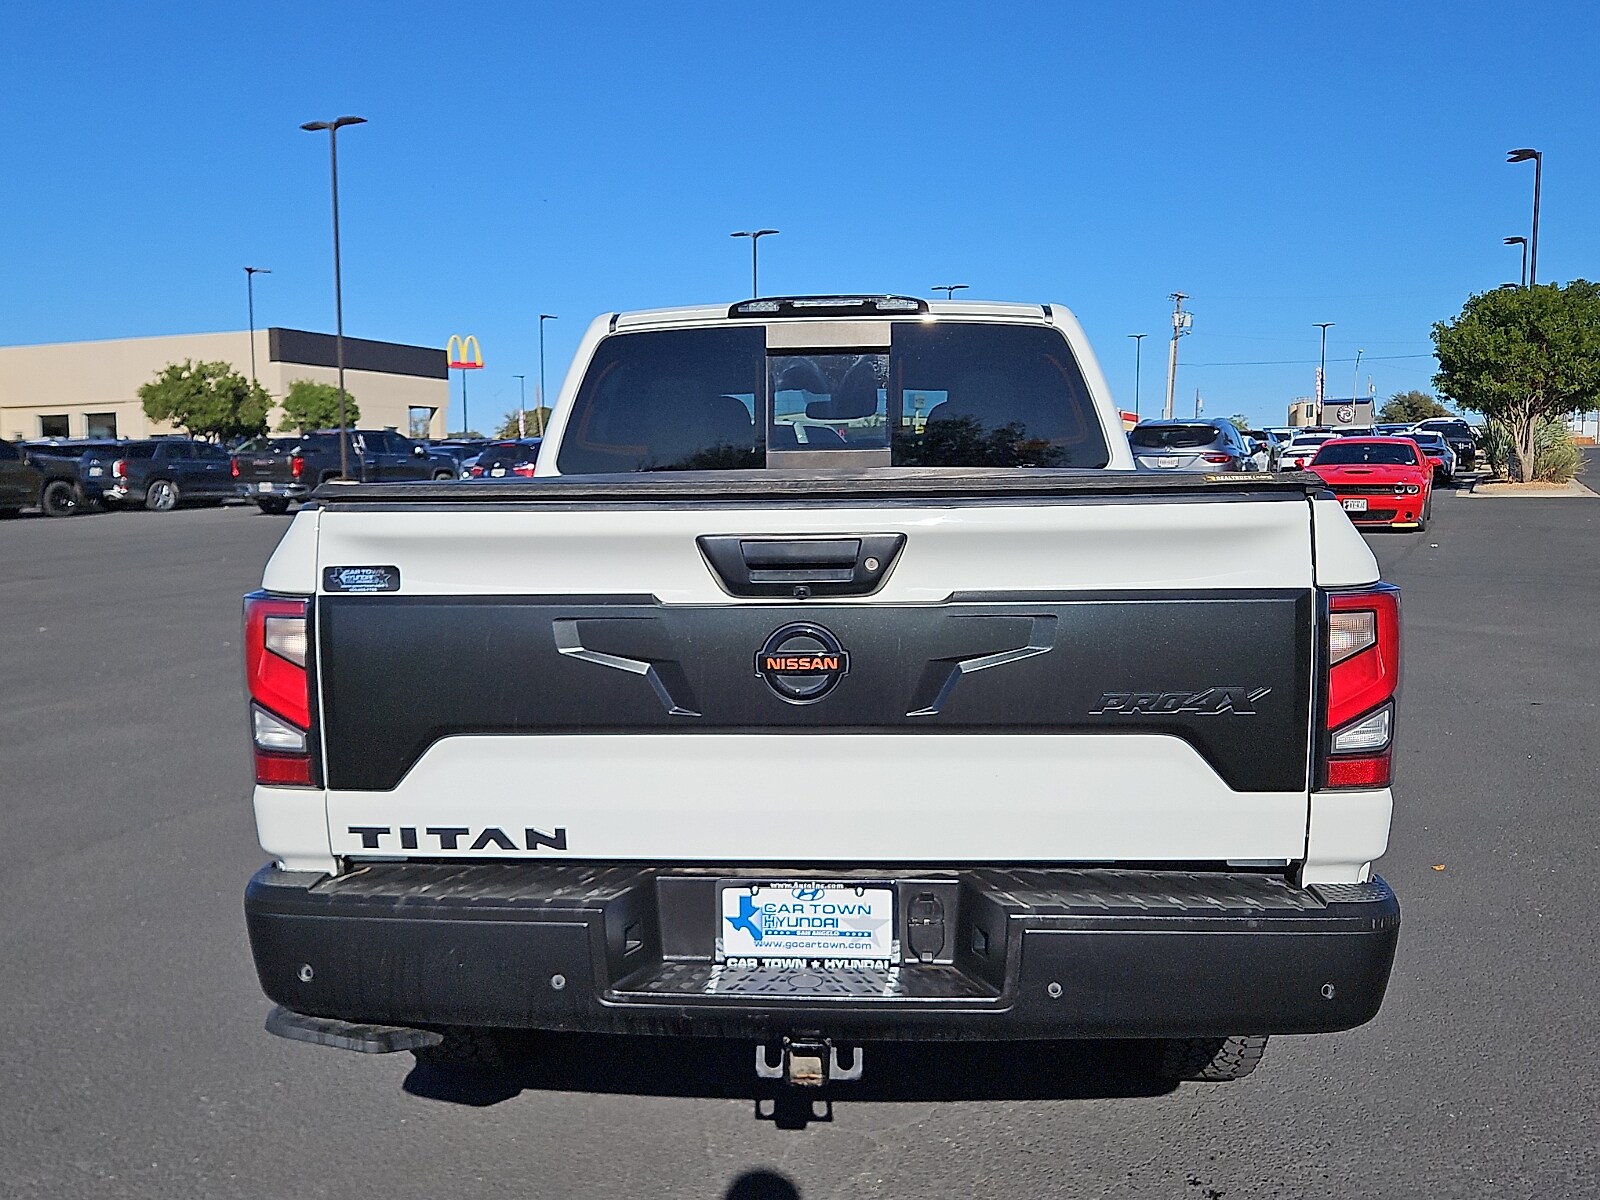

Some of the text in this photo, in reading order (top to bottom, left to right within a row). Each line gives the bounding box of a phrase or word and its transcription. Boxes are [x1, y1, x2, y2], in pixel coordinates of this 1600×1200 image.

[766, 657, 838, 670] NISSAN
[348, 826, 567, 850] TITAN
[764, 903, 872, 915] CAR TOWN
[764, 915, 839, 928] HYUNDAI
[754, 940, 872, 949] www.gocartown.com
[727, 958, 889, 969] CAR TOWN HYUNDAI
